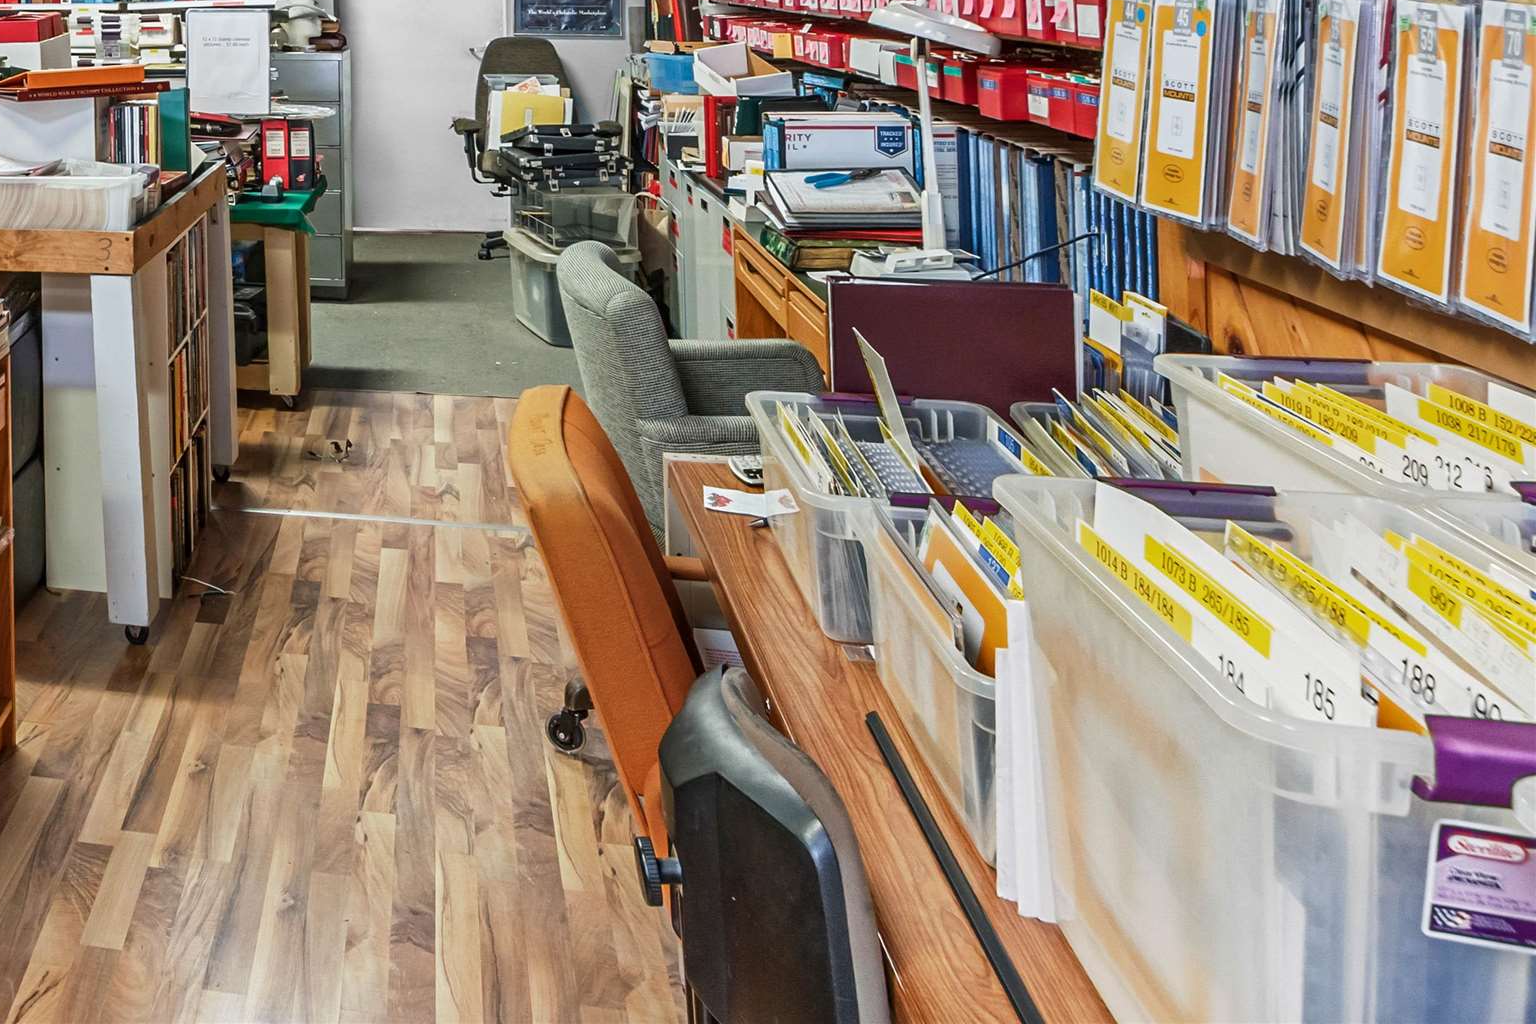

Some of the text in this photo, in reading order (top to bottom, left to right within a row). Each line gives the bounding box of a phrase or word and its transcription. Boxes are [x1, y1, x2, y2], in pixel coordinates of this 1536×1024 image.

[1507, 30, 1521, 57] 70
[101, 85, 137, 94] COLLECTION
[1164, 80, 1195, 91] SCOTT
[1407, 118, 1440, 133] SCOTT
[96, 238, 112, 262] 3
[1281, 393, 1302, 416] 1019
[1304, 404, 1313, 420] B
[1318, 411, 1359, 443] 182/209
[1449, 394, 1476, 417] 1008
[1479, 407, 1487, 422] B
[1436, 409, 1517, 457] 1038 217/179
[1402, 454, 1429, 487] 209
[1095, 540, 1175, 624] 1014 B 184/184
[1161, 551, 1250, 637] 1073 B 265/185
[1430, 585, 1457, 617] 997
[1218, 654, 1246, 695] 184
[1402, 657, 1436, 705] 188
[1304, 673, 1336, 721] 185
[1466, 684, 1503, 720] 90
